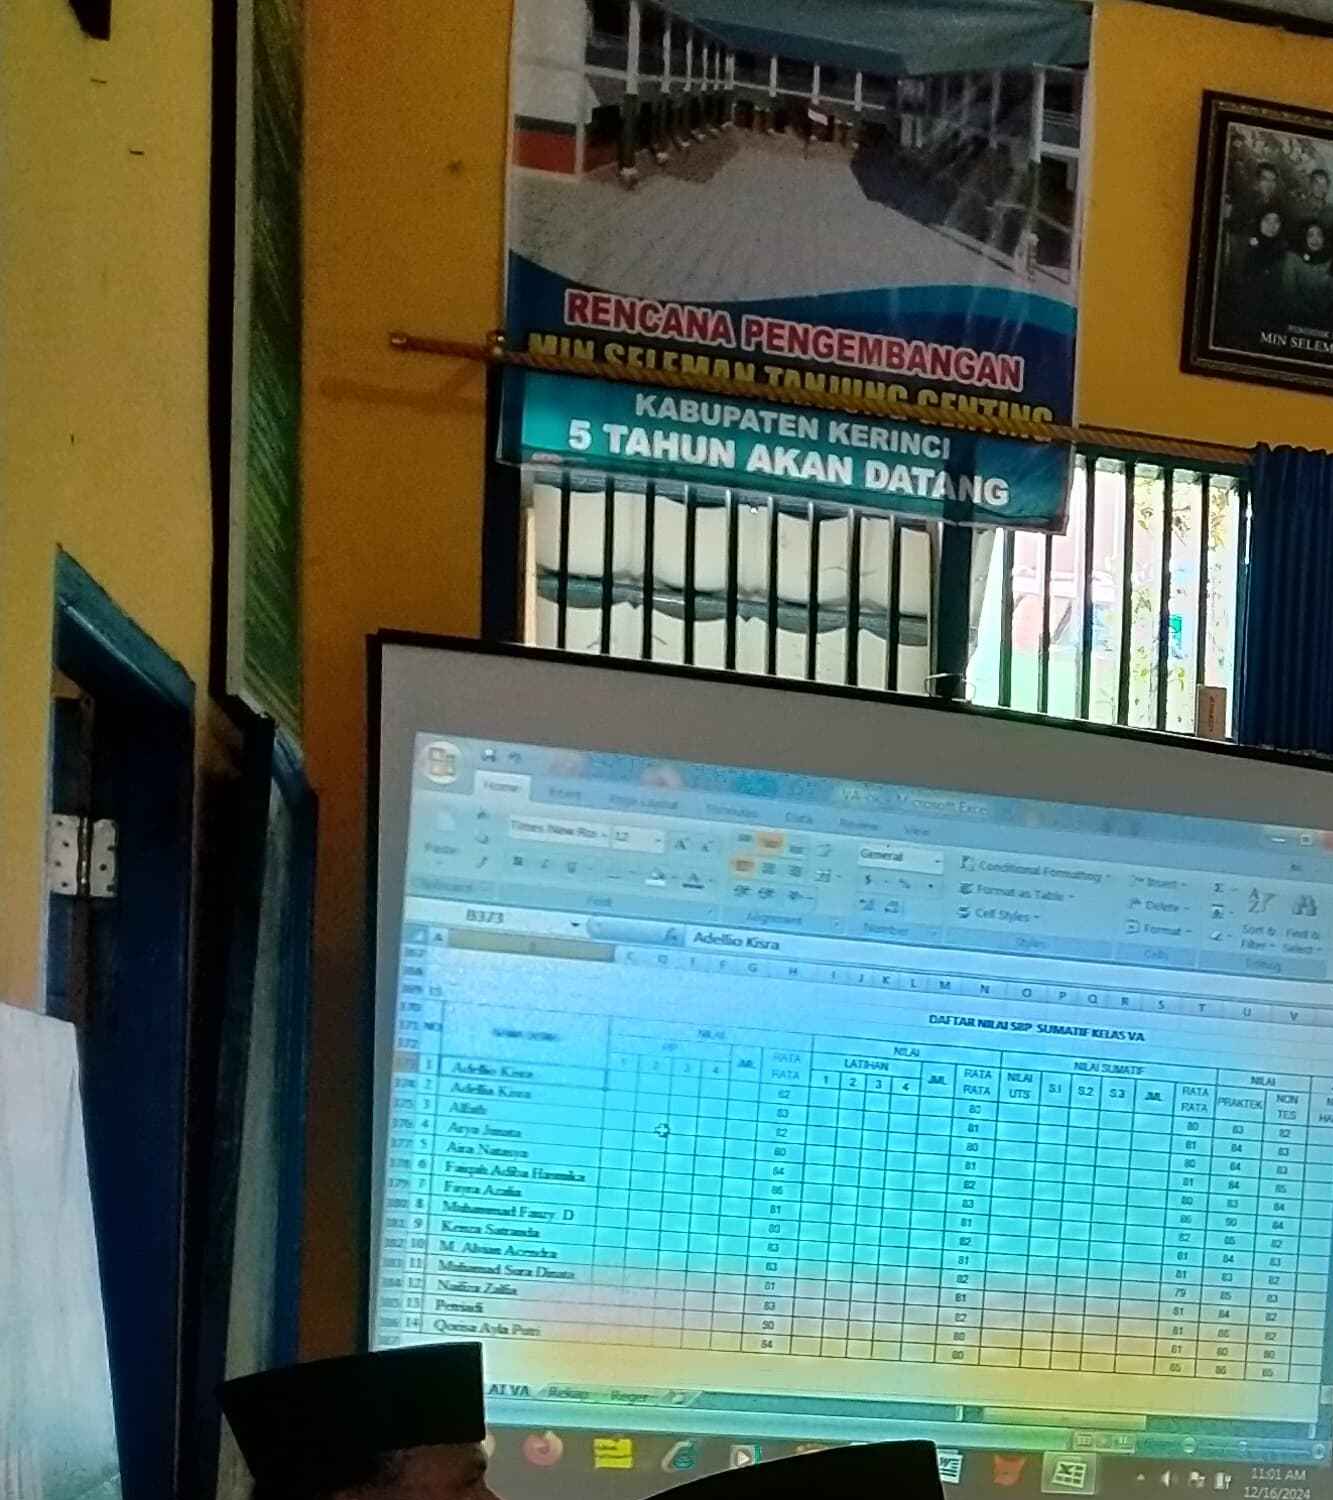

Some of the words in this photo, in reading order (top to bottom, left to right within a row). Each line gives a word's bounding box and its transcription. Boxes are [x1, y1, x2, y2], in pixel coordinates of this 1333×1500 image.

[564, 289, 734, 348] RENCANA
[742, 316, 1024, 392] PENGEMBANGAN
[1260, 331, 1287, 346] MIN
[528, 332, 596, 368] MIN
[635, 394, 819, 441] KABUPATEN
[828, 421, 951, 460] KERINCI
[568, 420, 591, 450] 5
[603, 424, 736, 469] TAHUN
[746, 446, 854, 485] AKAN
[864, 465, 1010, 506] DATANG
[860, 848, 904, 861] General
[979, 860, 1040, 875] Conditional
[466, 909, 504, 924] B373
[745, 936, 780, 950] Kisra
[928, 1014, 976, 1028] DAFTAR
[978, 1018, 1009, 1031] NILAI
[1036, 1024, 1090, 1037] SUMATIF
[1092, 1029, 1125, 1041] KELAS
[1127, 1031, 1145, 1042] VA
[773, 1052, 801, 1064] RATA
[893, 1047, 920, 1057] NILAI
[844, 1058, 889, 1071] LATIHAN
[1073, 1062, 1099, 1072] NILAI
[1101, 1064, 1145, 1075] SUMATIF
[964, 1068, 992, 1080] RATA
[1007, 1072, 1032, 1083] NILAI
[1251, 1075, 1277, 1087] NILAI
[963, 1084, 991, 1096] RATA
[1009, 1089, 1031, 1099] UTS
[1182, 1086, 1209, 1097] RATA
[1218, 1096, 1264, 1110] PRAKTEK
[1276, 1094, 1299, 1105] NON
[1181, 1102, 1208, 1113] RATA
[1277, 1109, 1297, 1120] TES
[562, 1209, 574, 1221] D
[1284, 1469, 1306, 1481] AM
[1244, 1486, 1311, 1500] 12/16/2024
